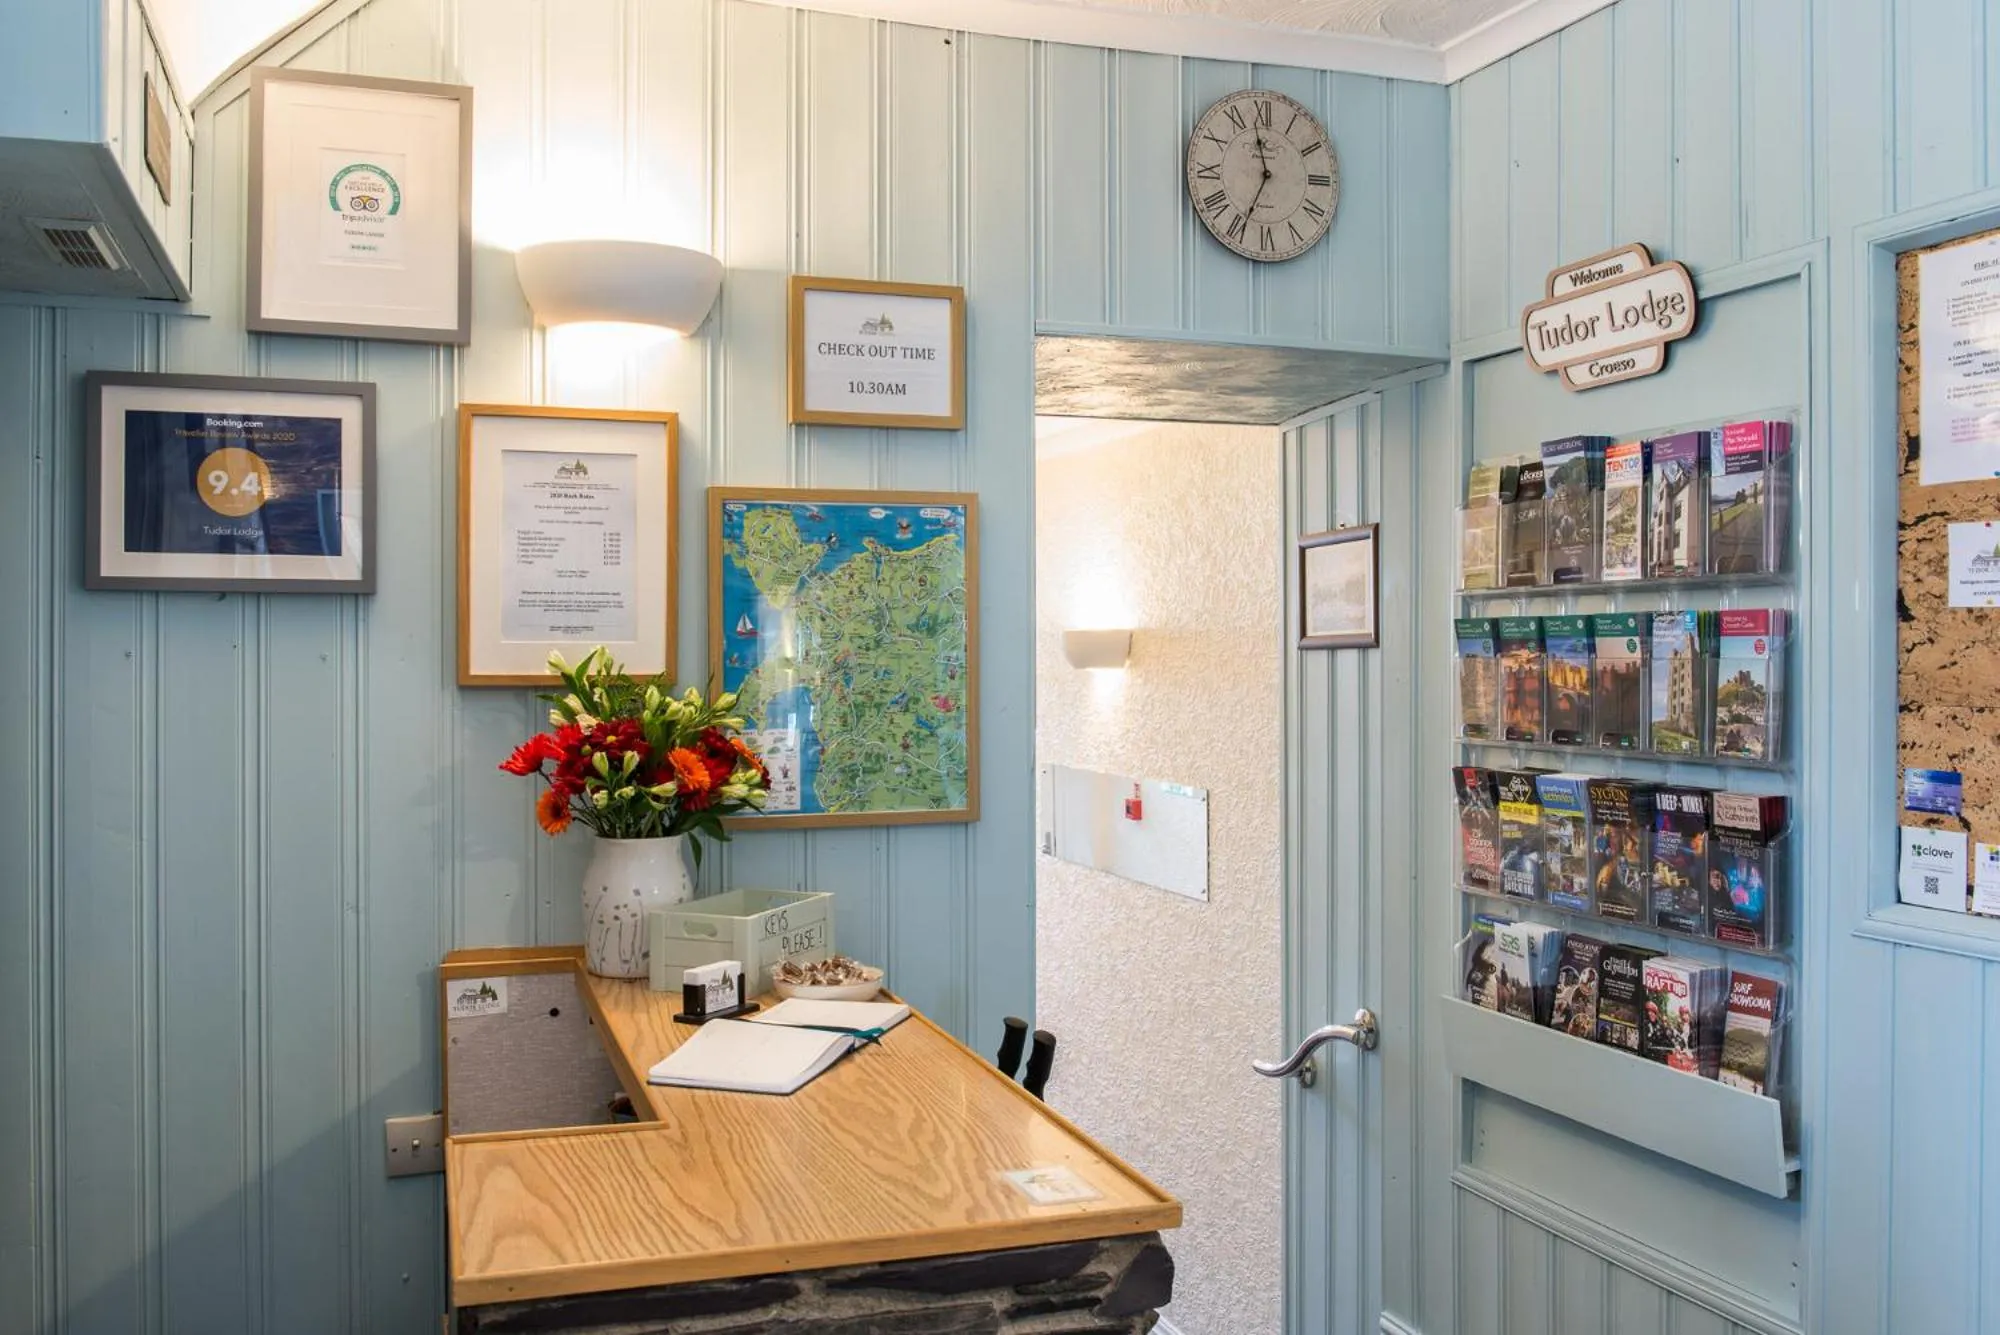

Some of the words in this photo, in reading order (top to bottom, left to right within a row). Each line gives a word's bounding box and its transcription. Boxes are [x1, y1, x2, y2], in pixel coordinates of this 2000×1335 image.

[1569, 263, 1624, 287] Welcome
[1530, 313, 1600, 351] Tudor
[1605, 289, 1686, 333] Lodge
[818, 342, 865, 357] CHECK
[868, 344, 897, 358] OUT
[900, 346, 936, 360] TIME
[1588, 357, 1636, 378] Croeso
[848, 380, 907, 396] 10.30AM
[206, 418, 264, 429] Booking.com
[272, 432, 296, 441] 2020
[208, 470, 262, 496] 9.4
[203, 526, 231, 536] Tudor
[234, 527, 263, 538] Lodge
[1589, 784, 1630, 802] SYGUN
[1922, 846, 1954, 859] clover
[1646, 975, 1687, 997] RAFTING
[1733, 982, 1753, 995] SURF
